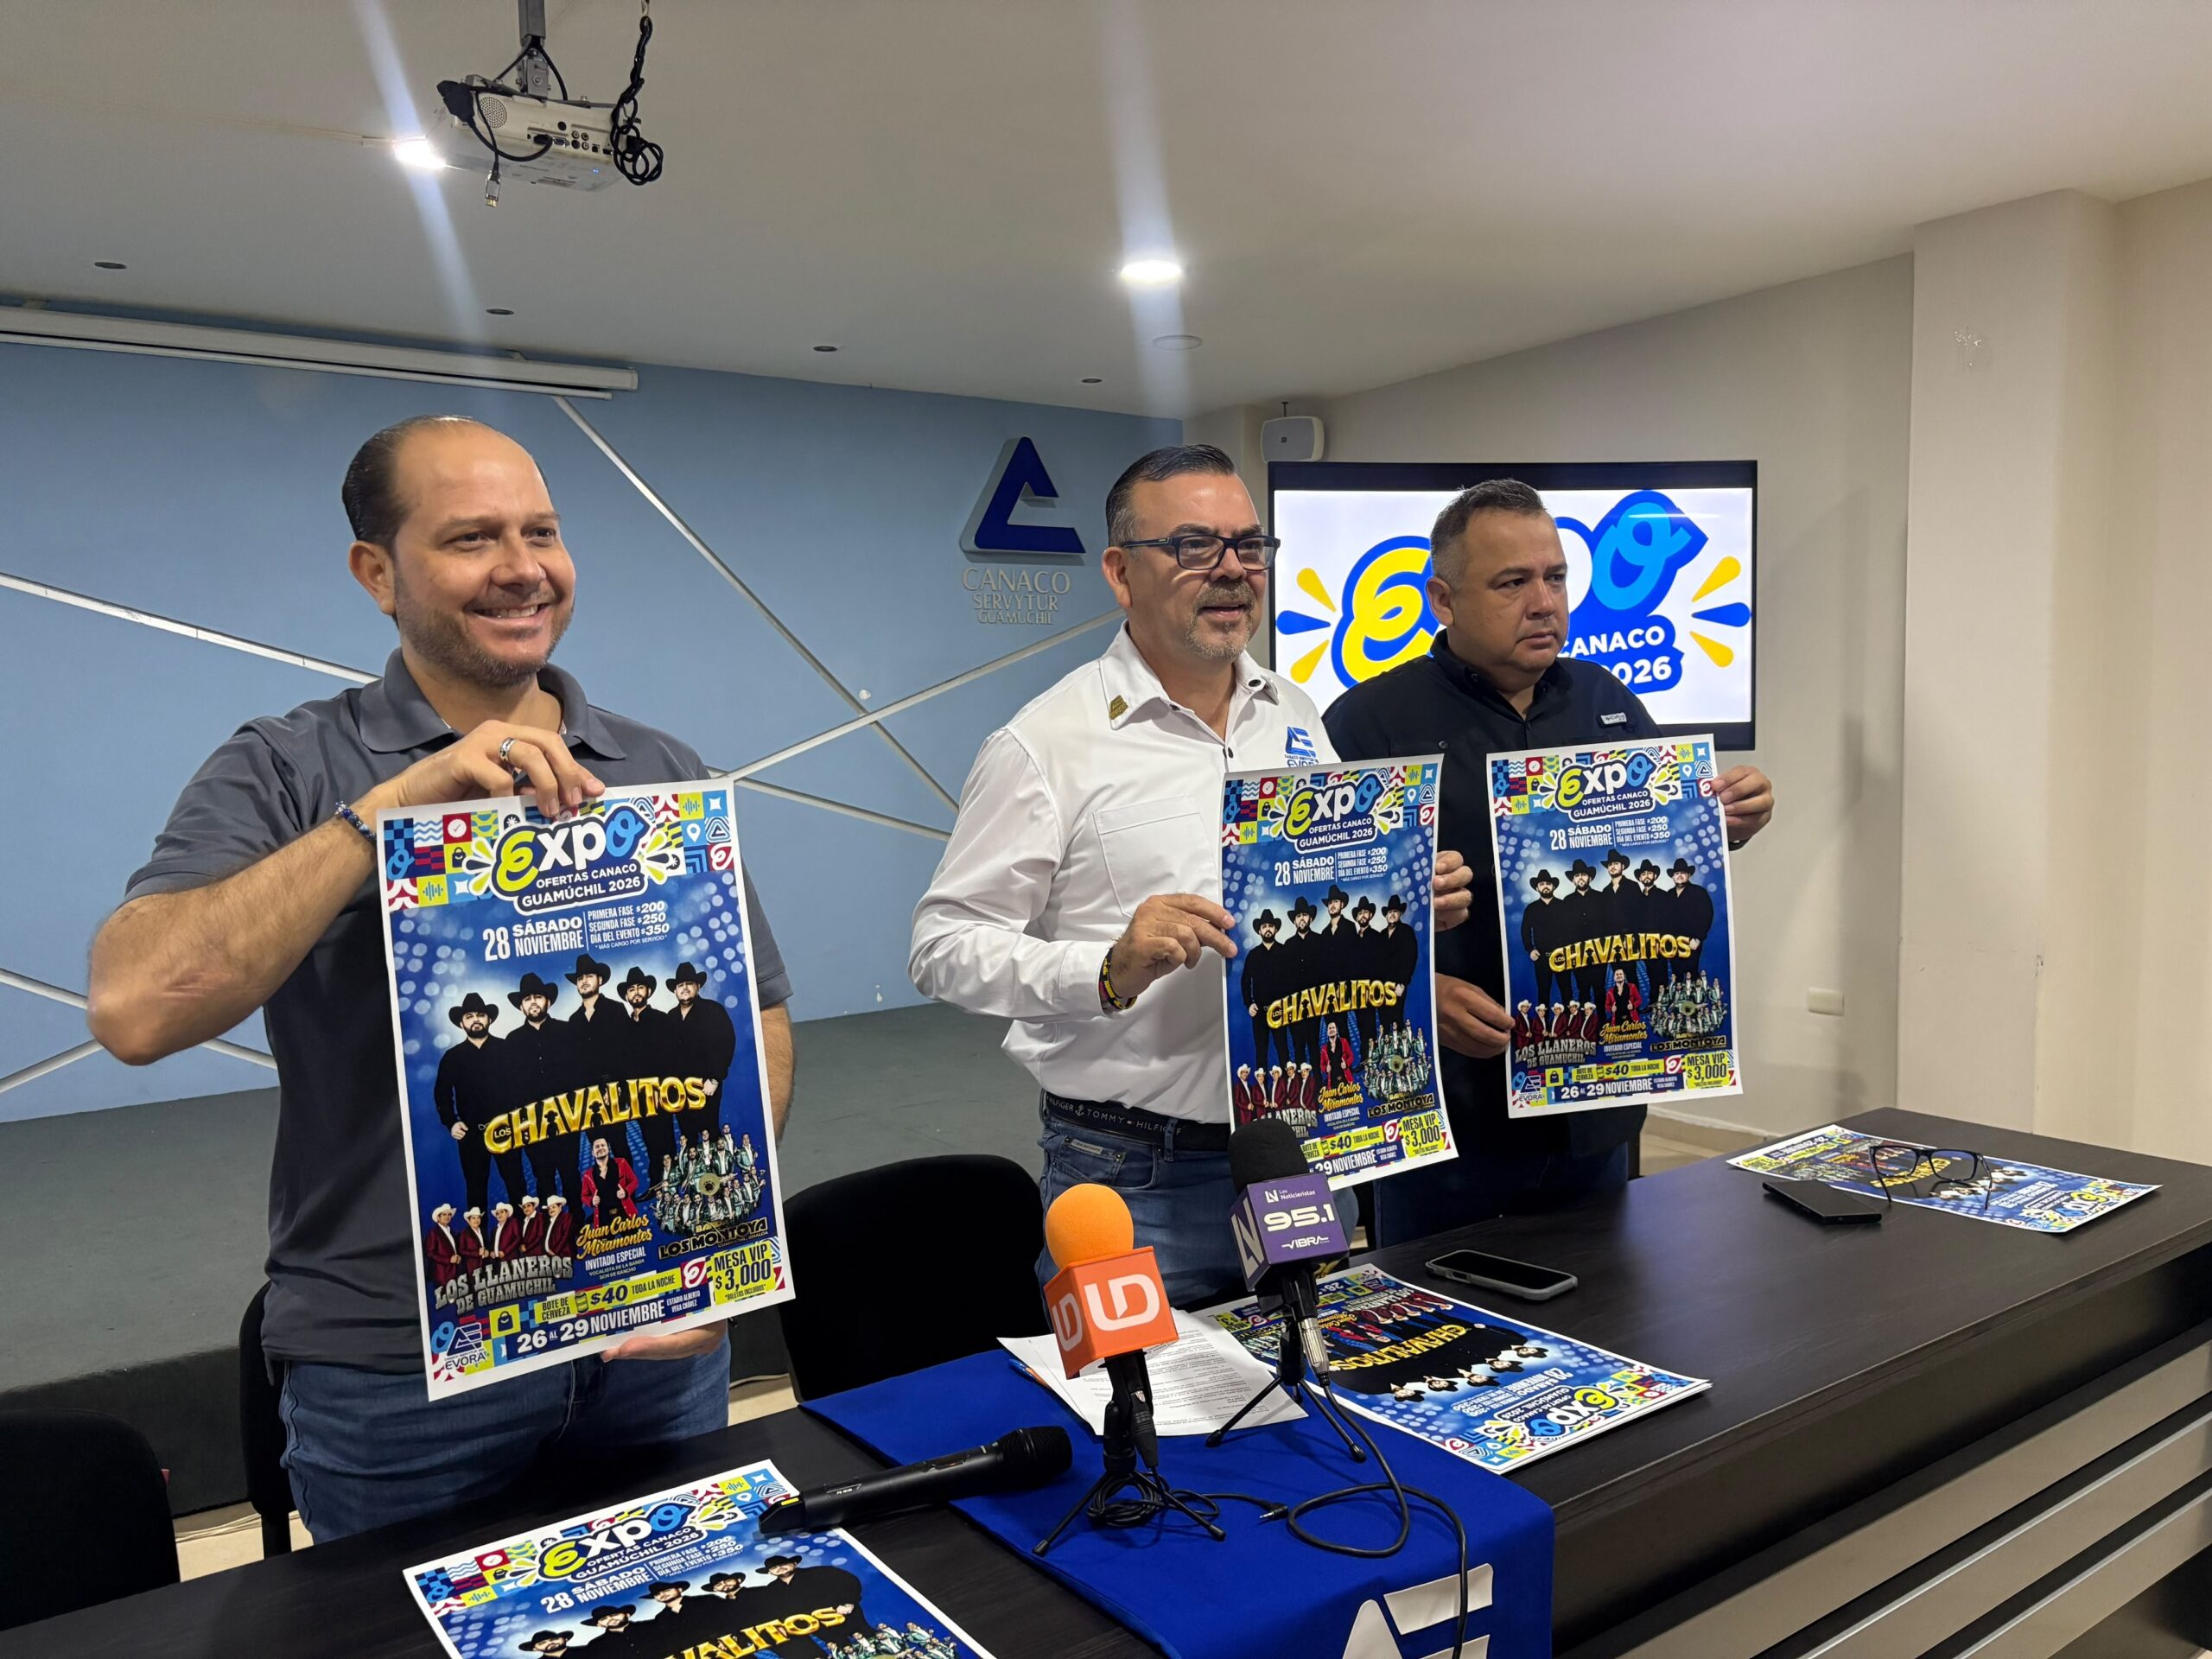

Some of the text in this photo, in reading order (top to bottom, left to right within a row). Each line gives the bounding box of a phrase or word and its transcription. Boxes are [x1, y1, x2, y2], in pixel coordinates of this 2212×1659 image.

[962, 567, 1071, 594] CANACO
[973, 594, 1058, 611] SERVYTUR
[978, 610, 1053, 626] GUAMUCHIL
[1601, 656, 1672, 687] 026
[1573, 799, 1650, 817] GUAMÚCHIL 2026
[1581, 790, 1649, 806] OFERTAS CANACO
[1309, 817, 1372, 835] OFERTAS CANACO
[1567, 824, 1611, 836] SÁBADO
[1648, 823, 1668, 832] $250
[1650, 831, 1670, 840] $350
[1299, 827, 1373, 848] GUAMÚCHIL 2026
[1549, 829, 1567, 851] 28
[1569, 833, 1613, 849] NOVIEMBRE
[1292, 855, 1335, 869] SÁBADO
[1367, 847, 1387, 856] $200
[1368, 855, 1387, 865] $250
[536, 863, 638, 889] OFERTAS CANACO
[1274, 861, 1291, 887] 28
[1294, 866, 1335, 885] NOVIEMBRE
[1370, 864, 1388, 873] $350
[521, 877, 641, 907] GUAMÚCHIL 2026
[588, 900, 666, 921] PRIMERA FASE $200
[512, 916, 582, 937] SÁBADO
[588, 912, 666, 932] SEGUNDA FASE $250
[482, 926, 511, 962] 28
[514, 929, 584, 958] NOVIEMBRE
[590, 923, 671, 944] DÍA DEL EVENTO $350
[1548, 932, 1692, 973] CHAVALITOS
[1266, 978, 1397, 1029] CHAVALITOS
[1599, 1020, 1646, 1037] Juan Carlos
[1599, 1030, 1648, 1046] Miramontes
[1515, 1044, 1535, 1064] LOS
[1538, 1038, 1597, 1056] LLANEROS
[1650, 1042, 1671, 1052] LOS
[1672, 1035, 1726, 1050] MONTOYA
[1527, 1052, 1586, 1068] DE GUAMUCHIL
[1687, 1053, 1726, 1066] MESA VIP
[1605, 1064, 1629, 1077] $40
[1318, 1081, 1361, 1103] Juan Carlos
[1561, 1086, 1580, 1100] 26
[1586, 1084, 1605, 1096] 29
[1605, 1077, 1653, 1094] NOVIEMBRE
[1319, 1093, 1363, 1114] Miramontes
[1368, 1106, 1386, 1119] LOS
[1387, 1092, 1435, 1113] MONTOYA
[484, 1077, 707, 1154] CHAVALITOS
[1086, 1109, 1125, 1123] TOMMY
[1135, 1120, 1181, 1135] HILFI
[1402, 1113, 1436, 1132] MESA VIP
[494, 1128, 512, 1139] LOS
[1330, 1135, 1351, 1151] $40
[1332, 1148, 1377, 1173] NOVIEMBRE
[1280, 1190, 1316, 1200] Noticieristas
[1263, 1204, 1335, 1232] 95.1
[576, 1213, 650, 1247] Juan Carlos
[658, 1239, 690, 1260] LOS
[690, 1217, 768, 1251] MONTOYA
[576, 1228, 653, 1260] Miramontes
[1281, 1236, 1329, 1249] VIBRA
[585, 1246, 646, 1271] INVITADO ESPECIAL
[714, 1244, 767, 1272] MESA VIP
[434, 1255, 574, 1310] LOS LLANEROS
[590, 1274, 676, 1306] $40 TODA LA NOCHE
[456, 1277, 556, 1315] DE GUAMUCHIL
[542, 1297, 569, 1311] BOTE DE
[666, 1290, 701, 1306] ESTADIO ALBERTO
[542, 1307, 571, 1320] CERVEZA
[671, 1302, 683, 1313] VEGA
[517, 1300, 666, 1354] 26 AL 29 NOVIEMBRE
[1332, 1324, 1468, 1371] CHAVALITOS
[1501, 1407, 1525, 1420] 2026
[575, 1545, 663, 1580] GUAMÚCHIL
[664, 1532, 700, 1548] 2026
[587, 1544, 641, 1567] OFERTAS
[643, 1527, 691, 1548] CANACO
[649, 1554, 681, 1567] PRIMERA
[681, 1546, 699, 1558] FASE
[652, 1560, 684, 1573] SEGUNDA
[684, 1551, 703, 1563] FASE
[657, 1554, 712, 1576] DÍA DEL EVENTO
[571, 1567, 646, 1595] SÁBADO
[576, 1571, 653, 1604] NOVIEMBRE
[540, 1592, 575, 1614] 28
